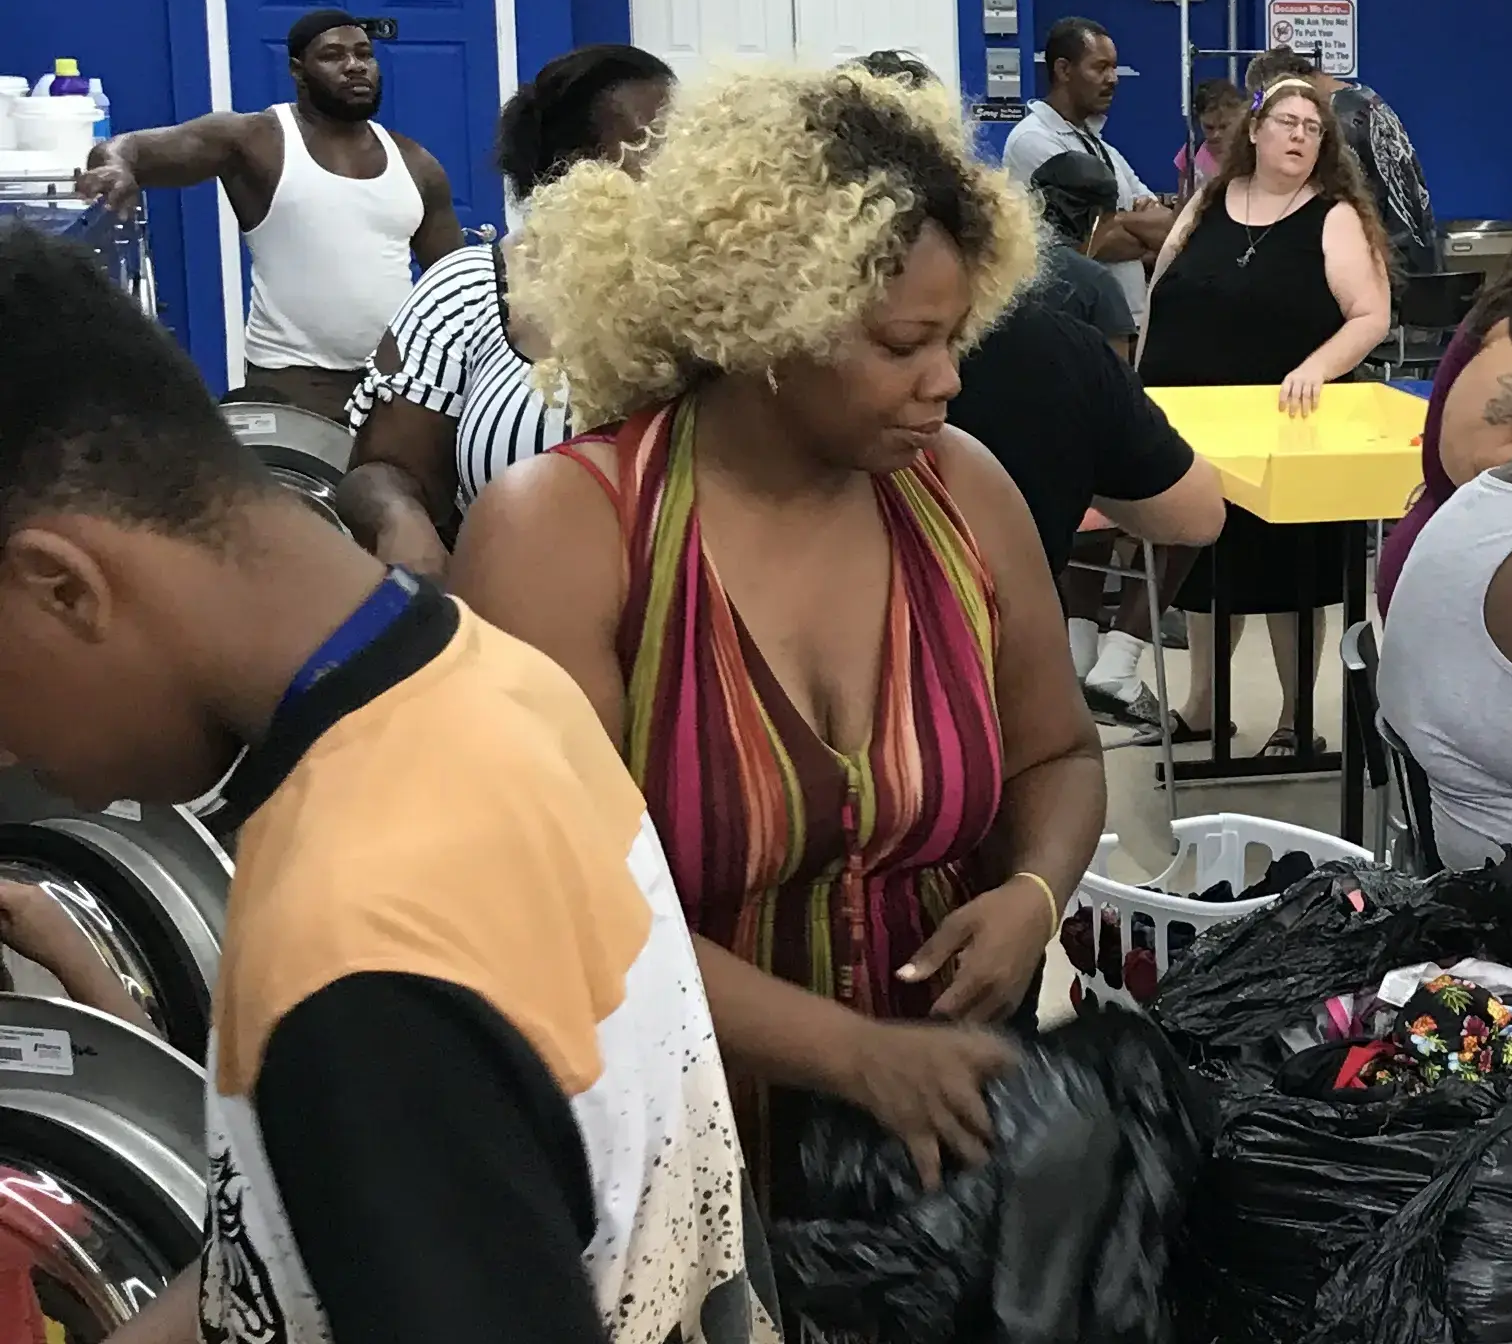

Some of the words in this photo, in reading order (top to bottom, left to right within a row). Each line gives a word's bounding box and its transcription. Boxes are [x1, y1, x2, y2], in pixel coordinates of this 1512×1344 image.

[1274, 4, 1308, 13] Because
[1309, 4, 1322, 13] We
[1294, 18, 1305, 26] We
[1306, 17, 1319, 26] Ask
[1321, 18, 1334, 26] You
[1335, 18, 1348, 26] Not
[1333, 41, 1346, 49] The
[1335, 52, 1349, 60] The
